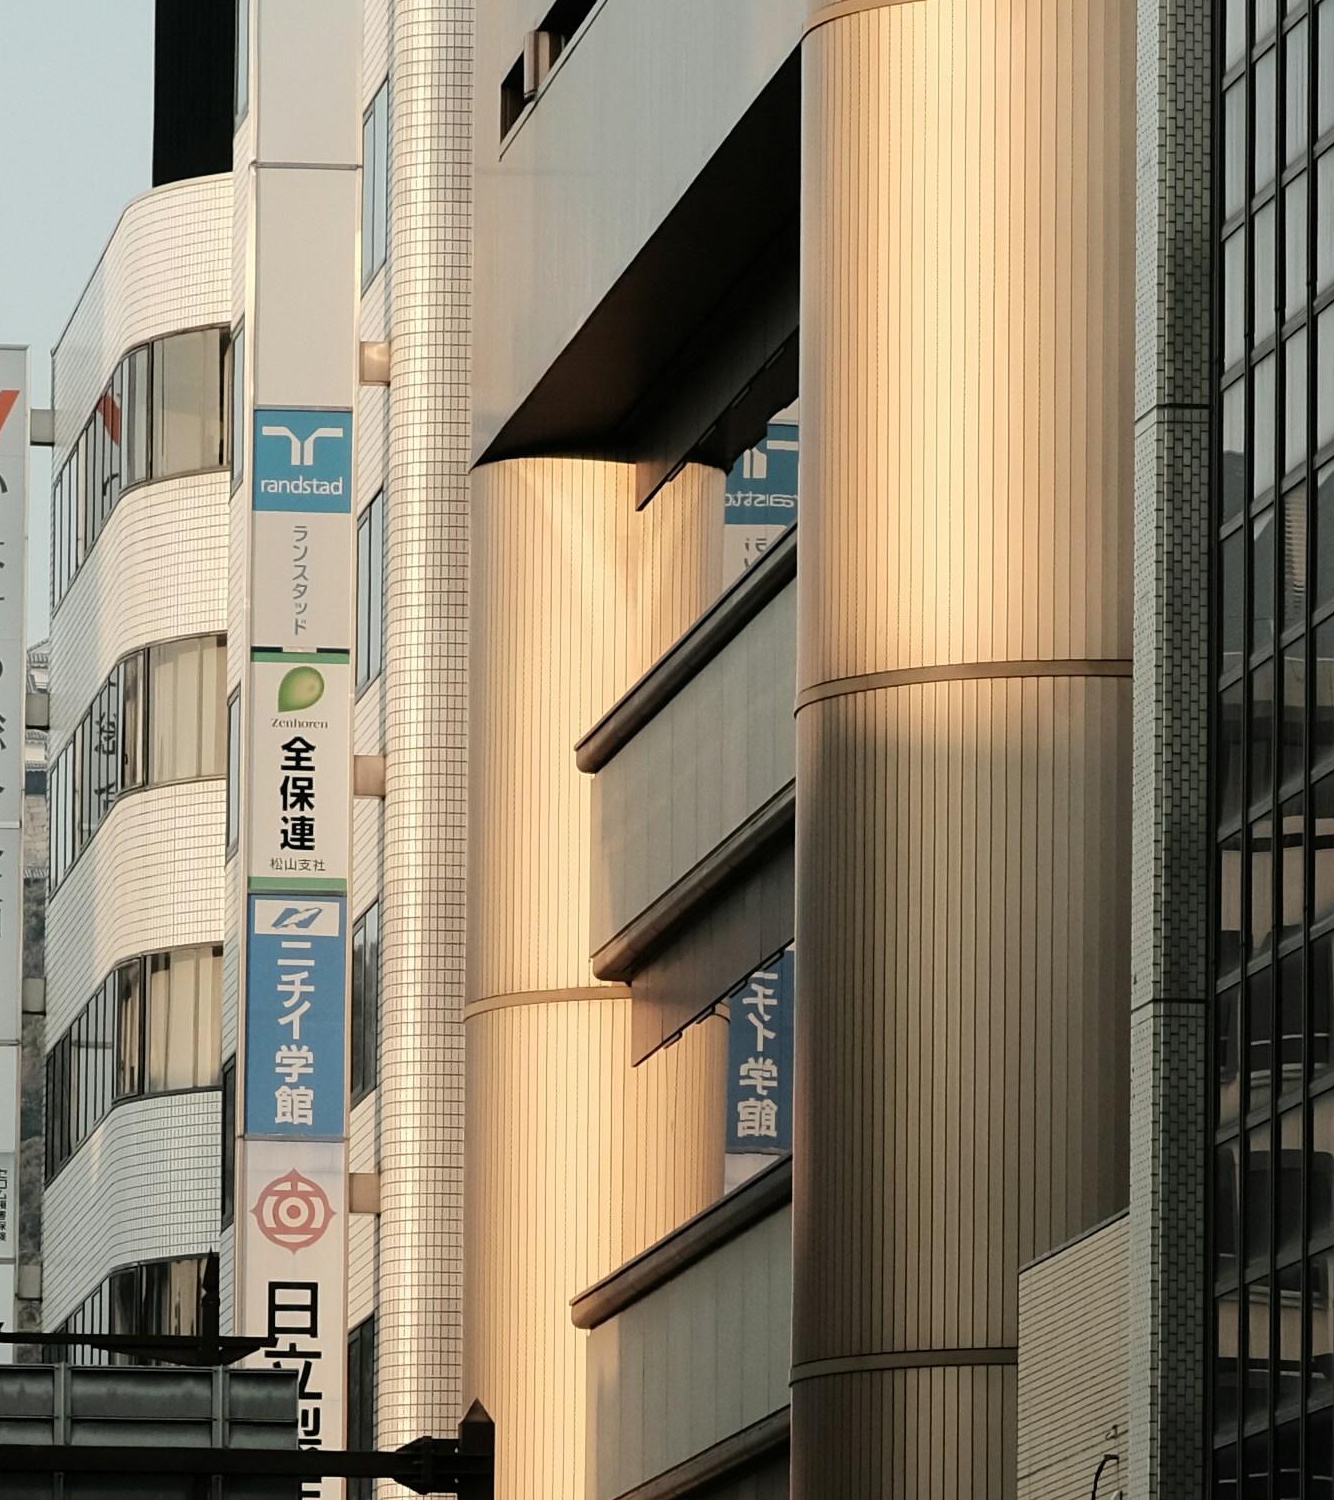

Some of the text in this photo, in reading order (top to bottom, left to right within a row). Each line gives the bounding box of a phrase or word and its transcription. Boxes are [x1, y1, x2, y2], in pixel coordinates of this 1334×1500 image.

[260, 475, 343, 496] randstad
[291, 524, 308, 636] ランスタッド
[270, 715, 329, 730] Zenhoren
[279, 736, 317, 852] 全保連
[269, 856, 327, 874] 松山支社
[274, 941, 316, 1127] ニチイ学館
